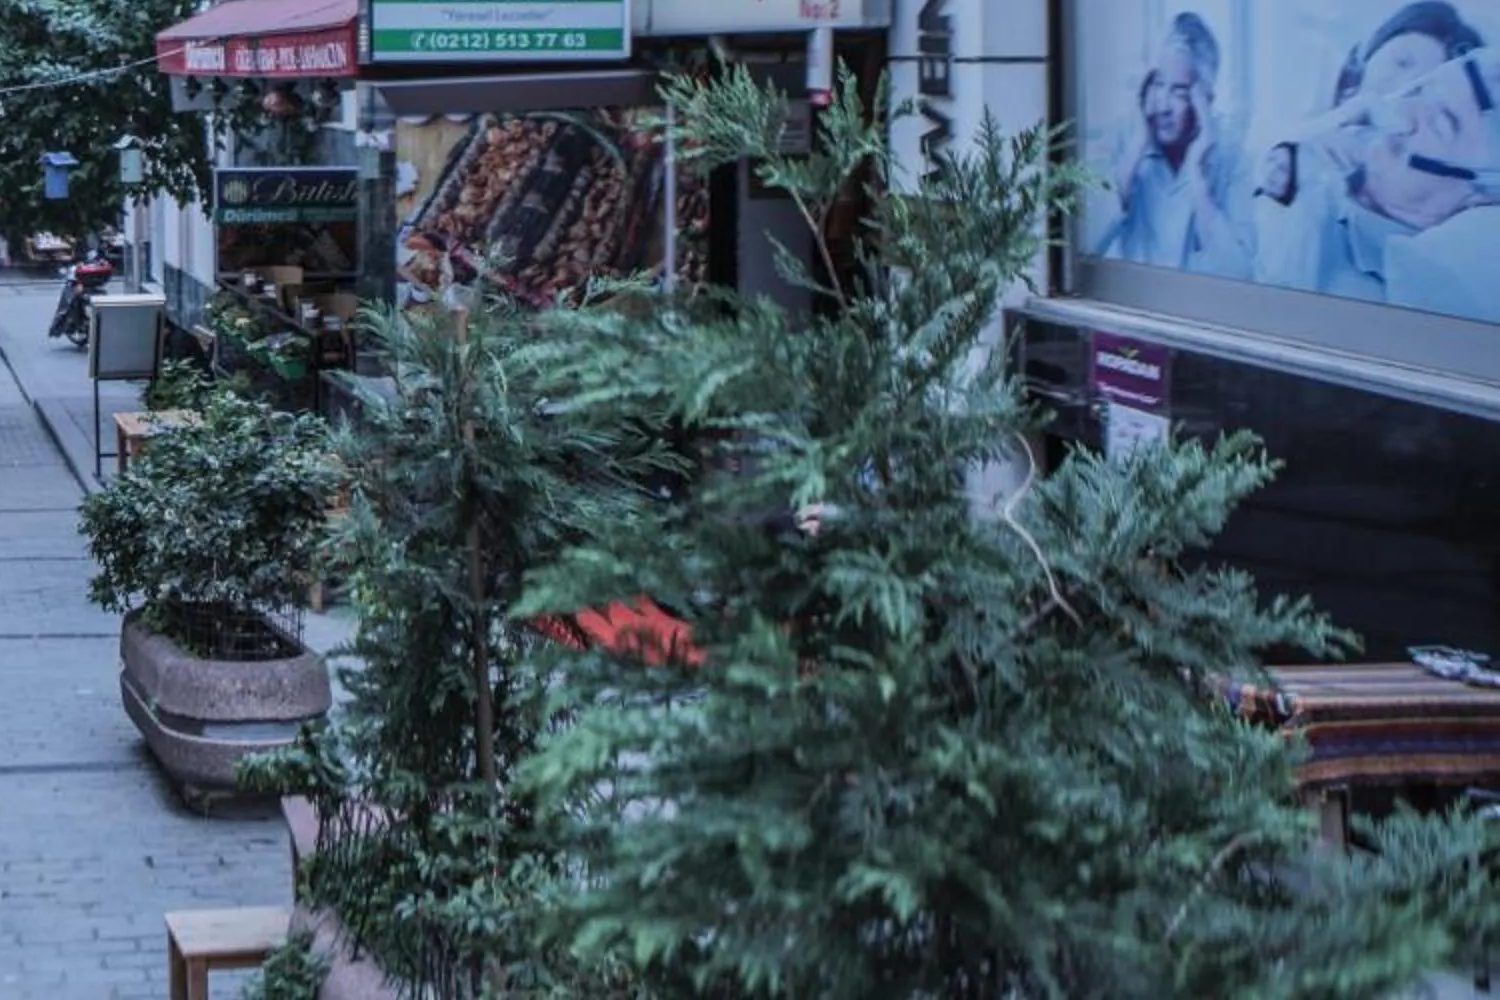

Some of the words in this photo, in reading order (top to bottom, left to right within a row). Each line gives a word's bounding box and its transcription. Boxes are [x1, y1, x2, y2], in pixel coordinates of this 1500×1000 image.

[430, 32, 490, 49] (0212)
[496, 34, 531, 48] 513
[536, 34, 557, 48] 77
